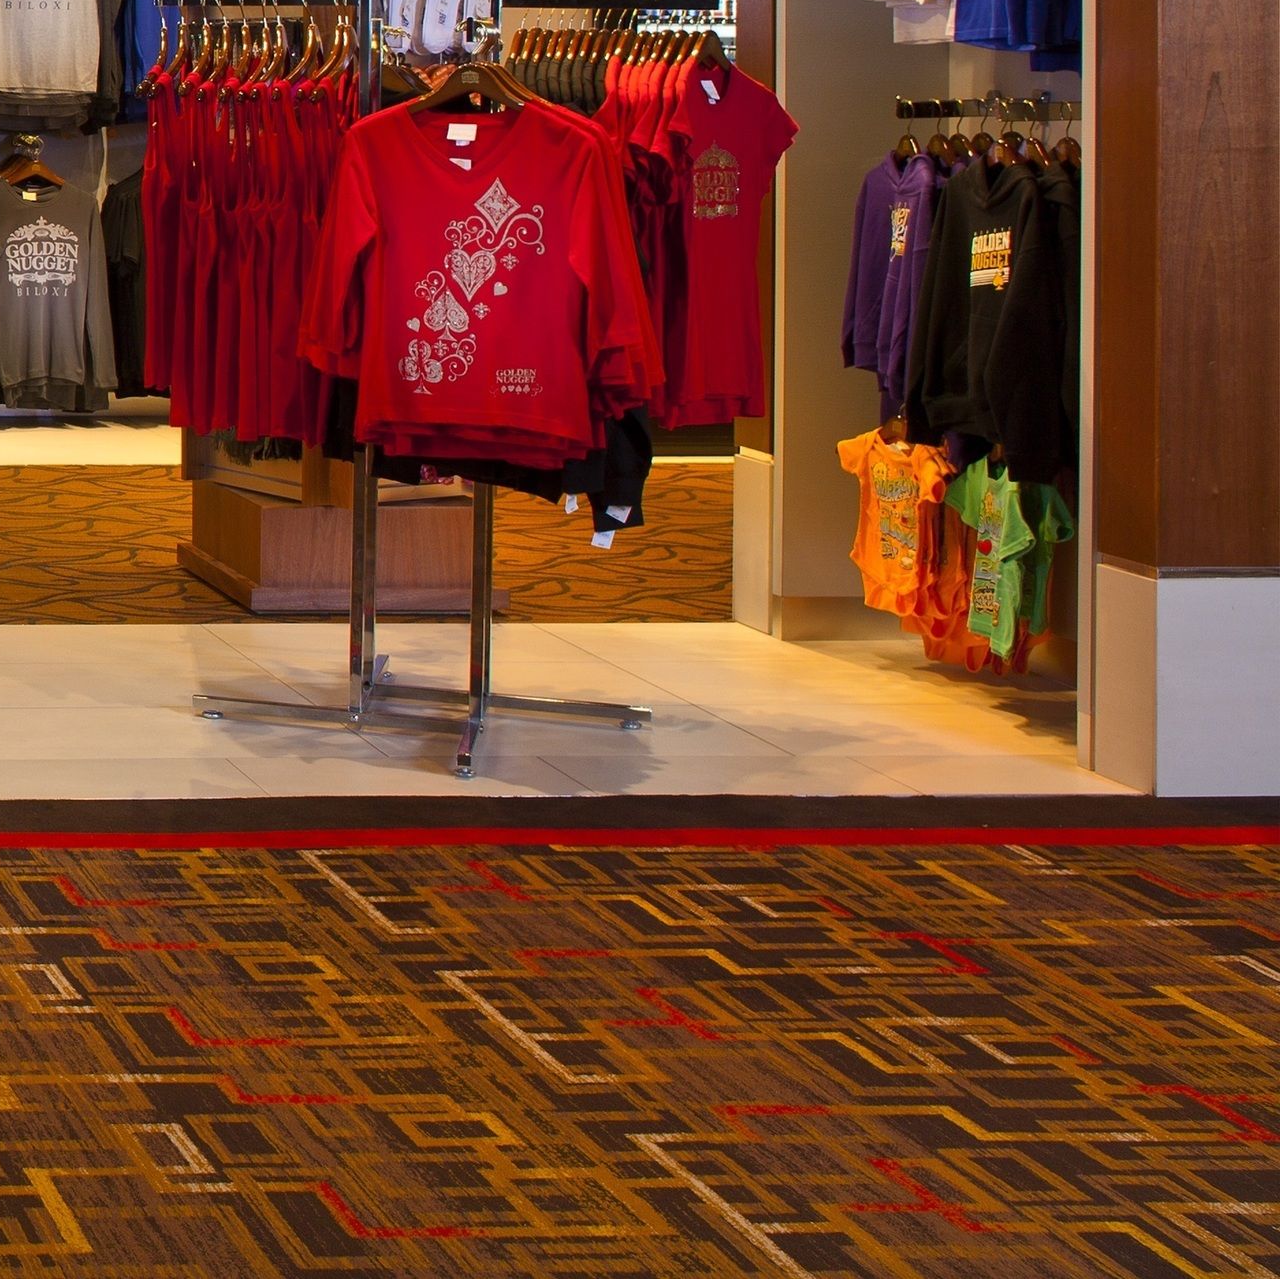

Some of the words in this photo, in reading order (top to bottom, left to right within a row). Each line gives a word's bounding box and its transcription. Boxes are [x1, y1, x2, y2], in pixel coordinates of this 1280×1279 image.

[5, 0, 70, 10] BILOXI
[971, 231, 1011, 254] GOLDEN
[5, 241, 79, 258] GOLDEN
[6, 256, 78, 272] NUGGET
[971, 249, 1011, 271] NUGGET
[17, 287, 68, 297] BILOXI
[495, 368, 537, 377] GOLDEN
[496, 376, 537, 384] NUGGET
